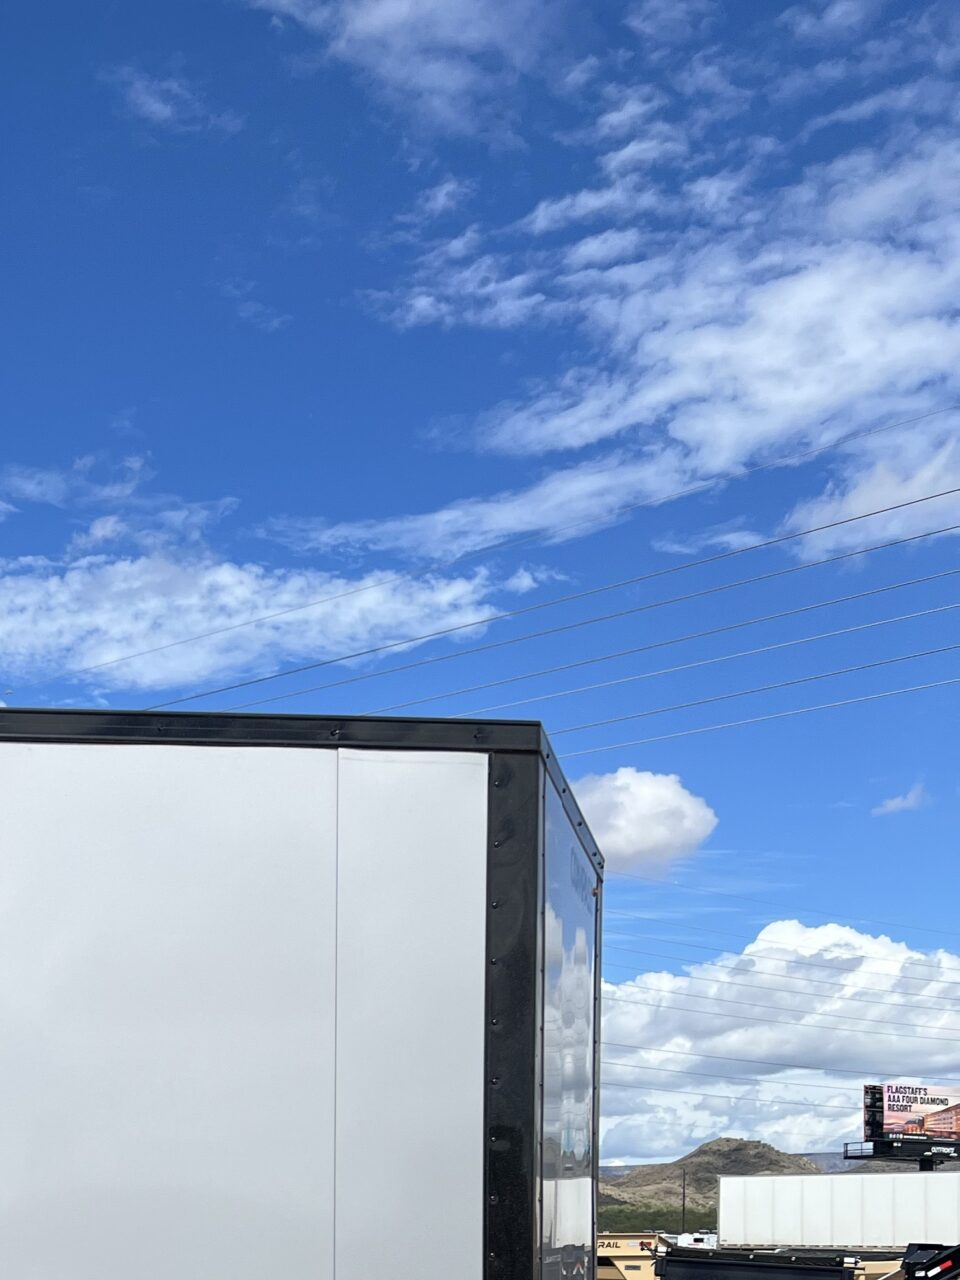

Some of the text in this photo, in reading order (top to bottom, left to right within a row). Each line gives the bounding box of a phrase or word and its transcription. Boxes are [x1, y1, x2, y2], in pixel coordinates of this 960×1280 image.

[887, 1086, 927, 1096] FLAGSTAFF'S
[888, 1095, 949, 1106] AAA FOUR DIAMOND
[888, 1103, 912, 1112] RESORT
[597, 1241, 621, 1249] RAIL
